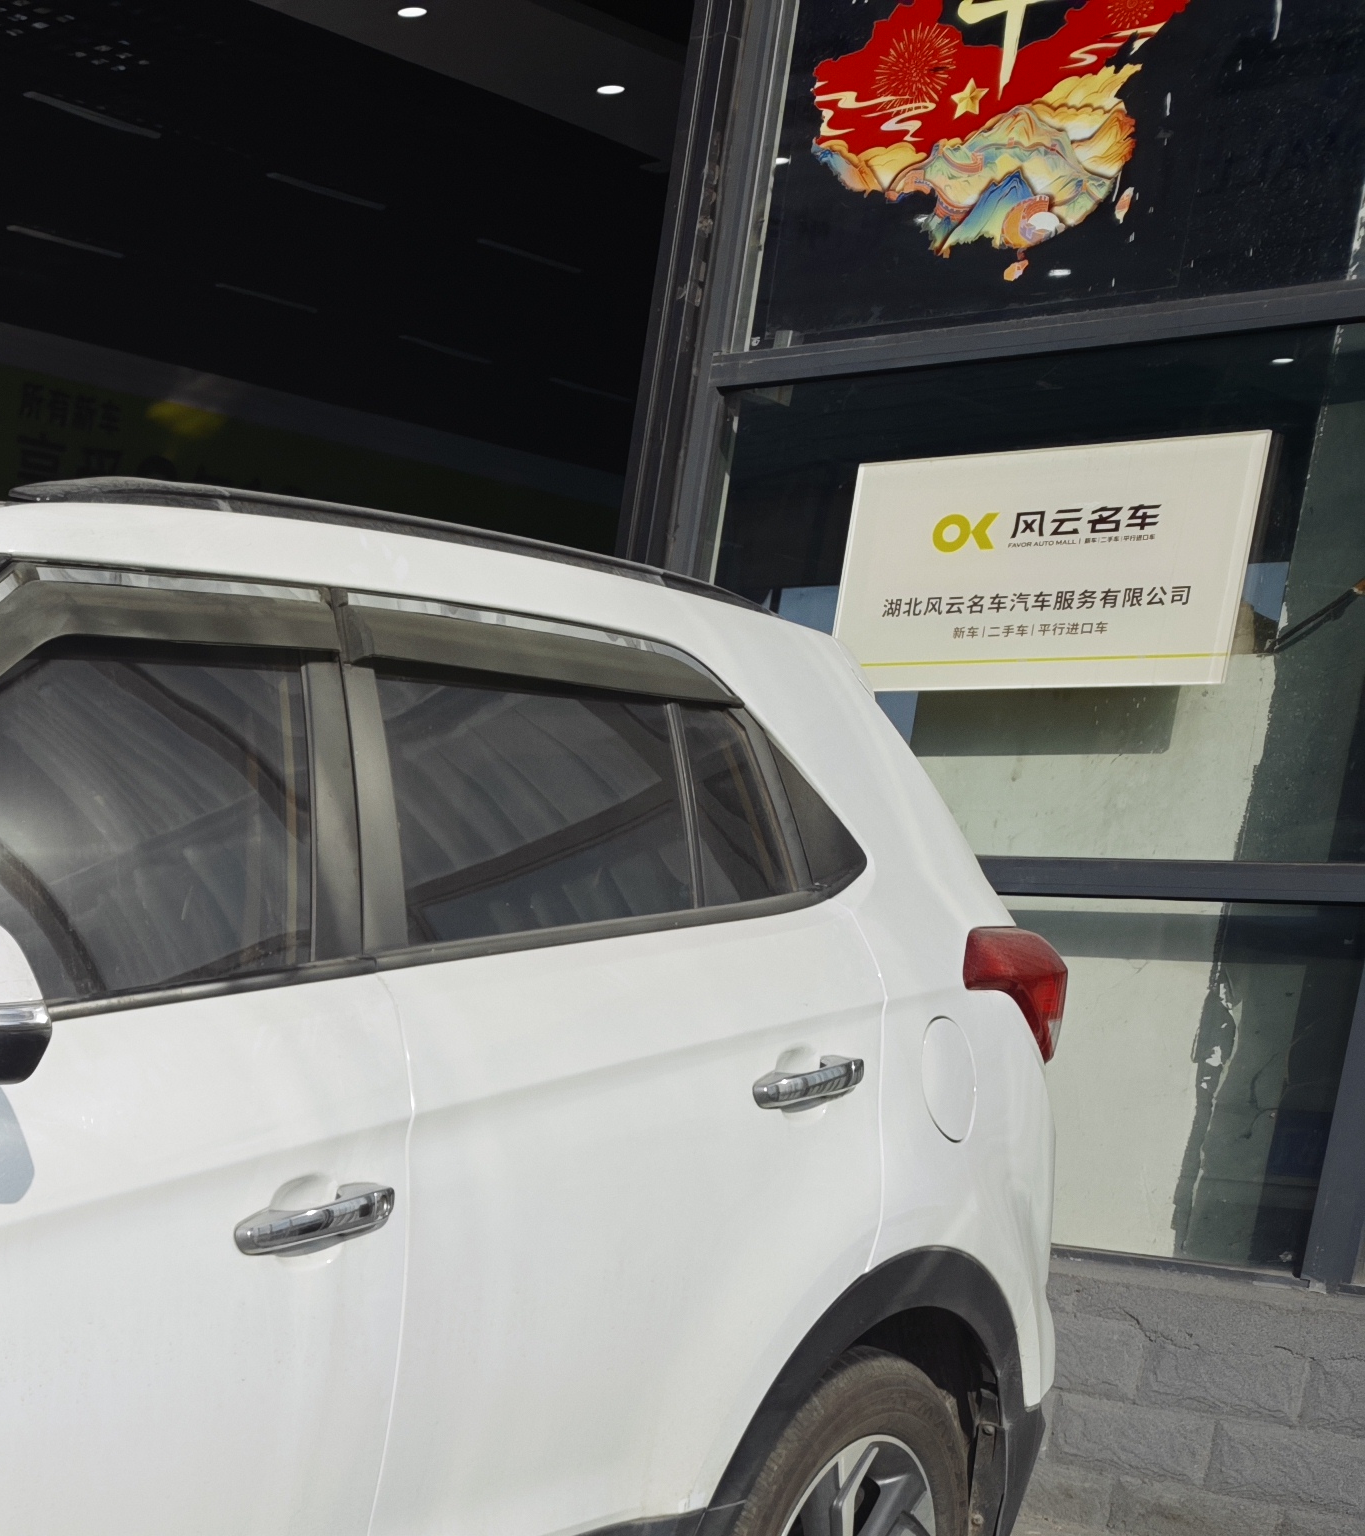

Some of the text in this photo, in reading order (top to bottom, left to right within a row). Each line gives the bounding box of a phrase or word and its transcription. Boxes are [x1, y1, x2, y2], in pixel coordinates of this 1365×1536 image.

[932, 511, 1000, 553] OK
[1010, 504, 1162, 539] 风云名车
[881, 585, 1192, 618] 湖北风云名车汽车服务有限公司
